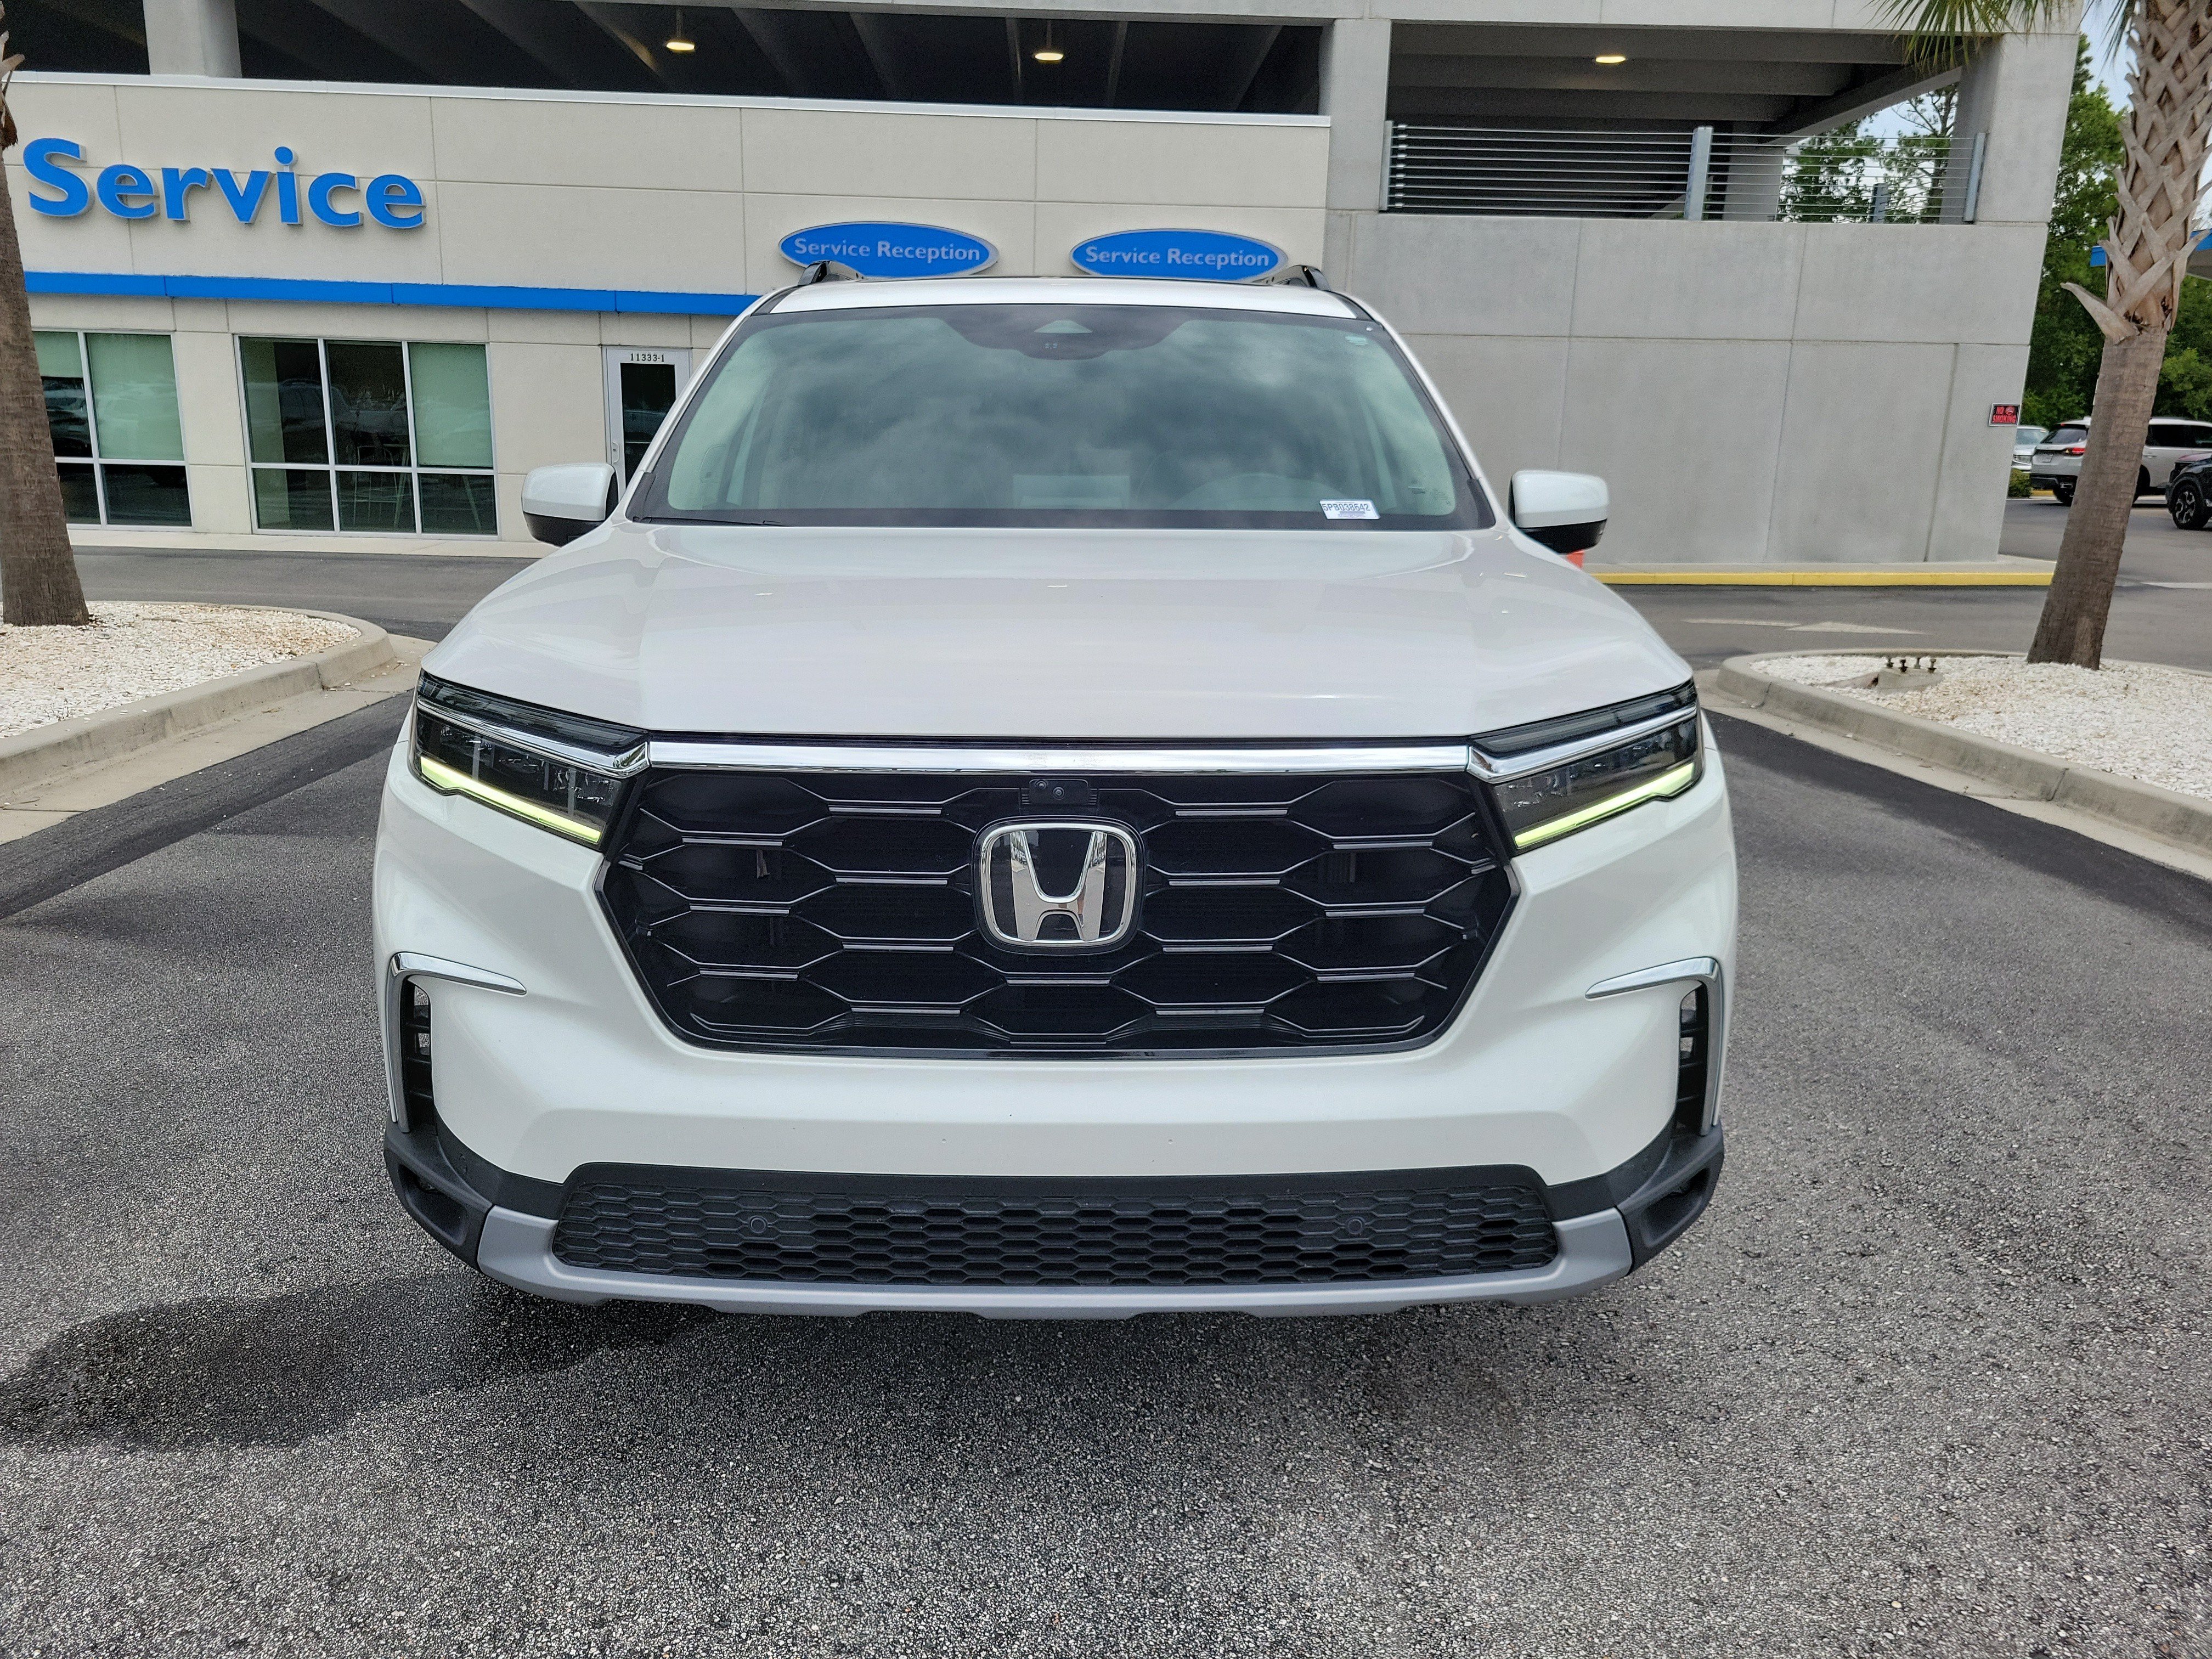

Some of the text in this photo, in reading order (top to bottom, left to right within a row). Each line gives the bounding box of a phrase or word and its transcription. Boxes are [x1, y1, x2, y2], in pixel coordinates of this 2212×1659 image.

[23, 138, 426, 229] Service
[794, 238, 980, 263] Service Reception
[1086, 246, 1269, 270] Service Reception
[630, 353, 664, 362] 11333-1
[1993, 415, 2016, 423] SMOKING
